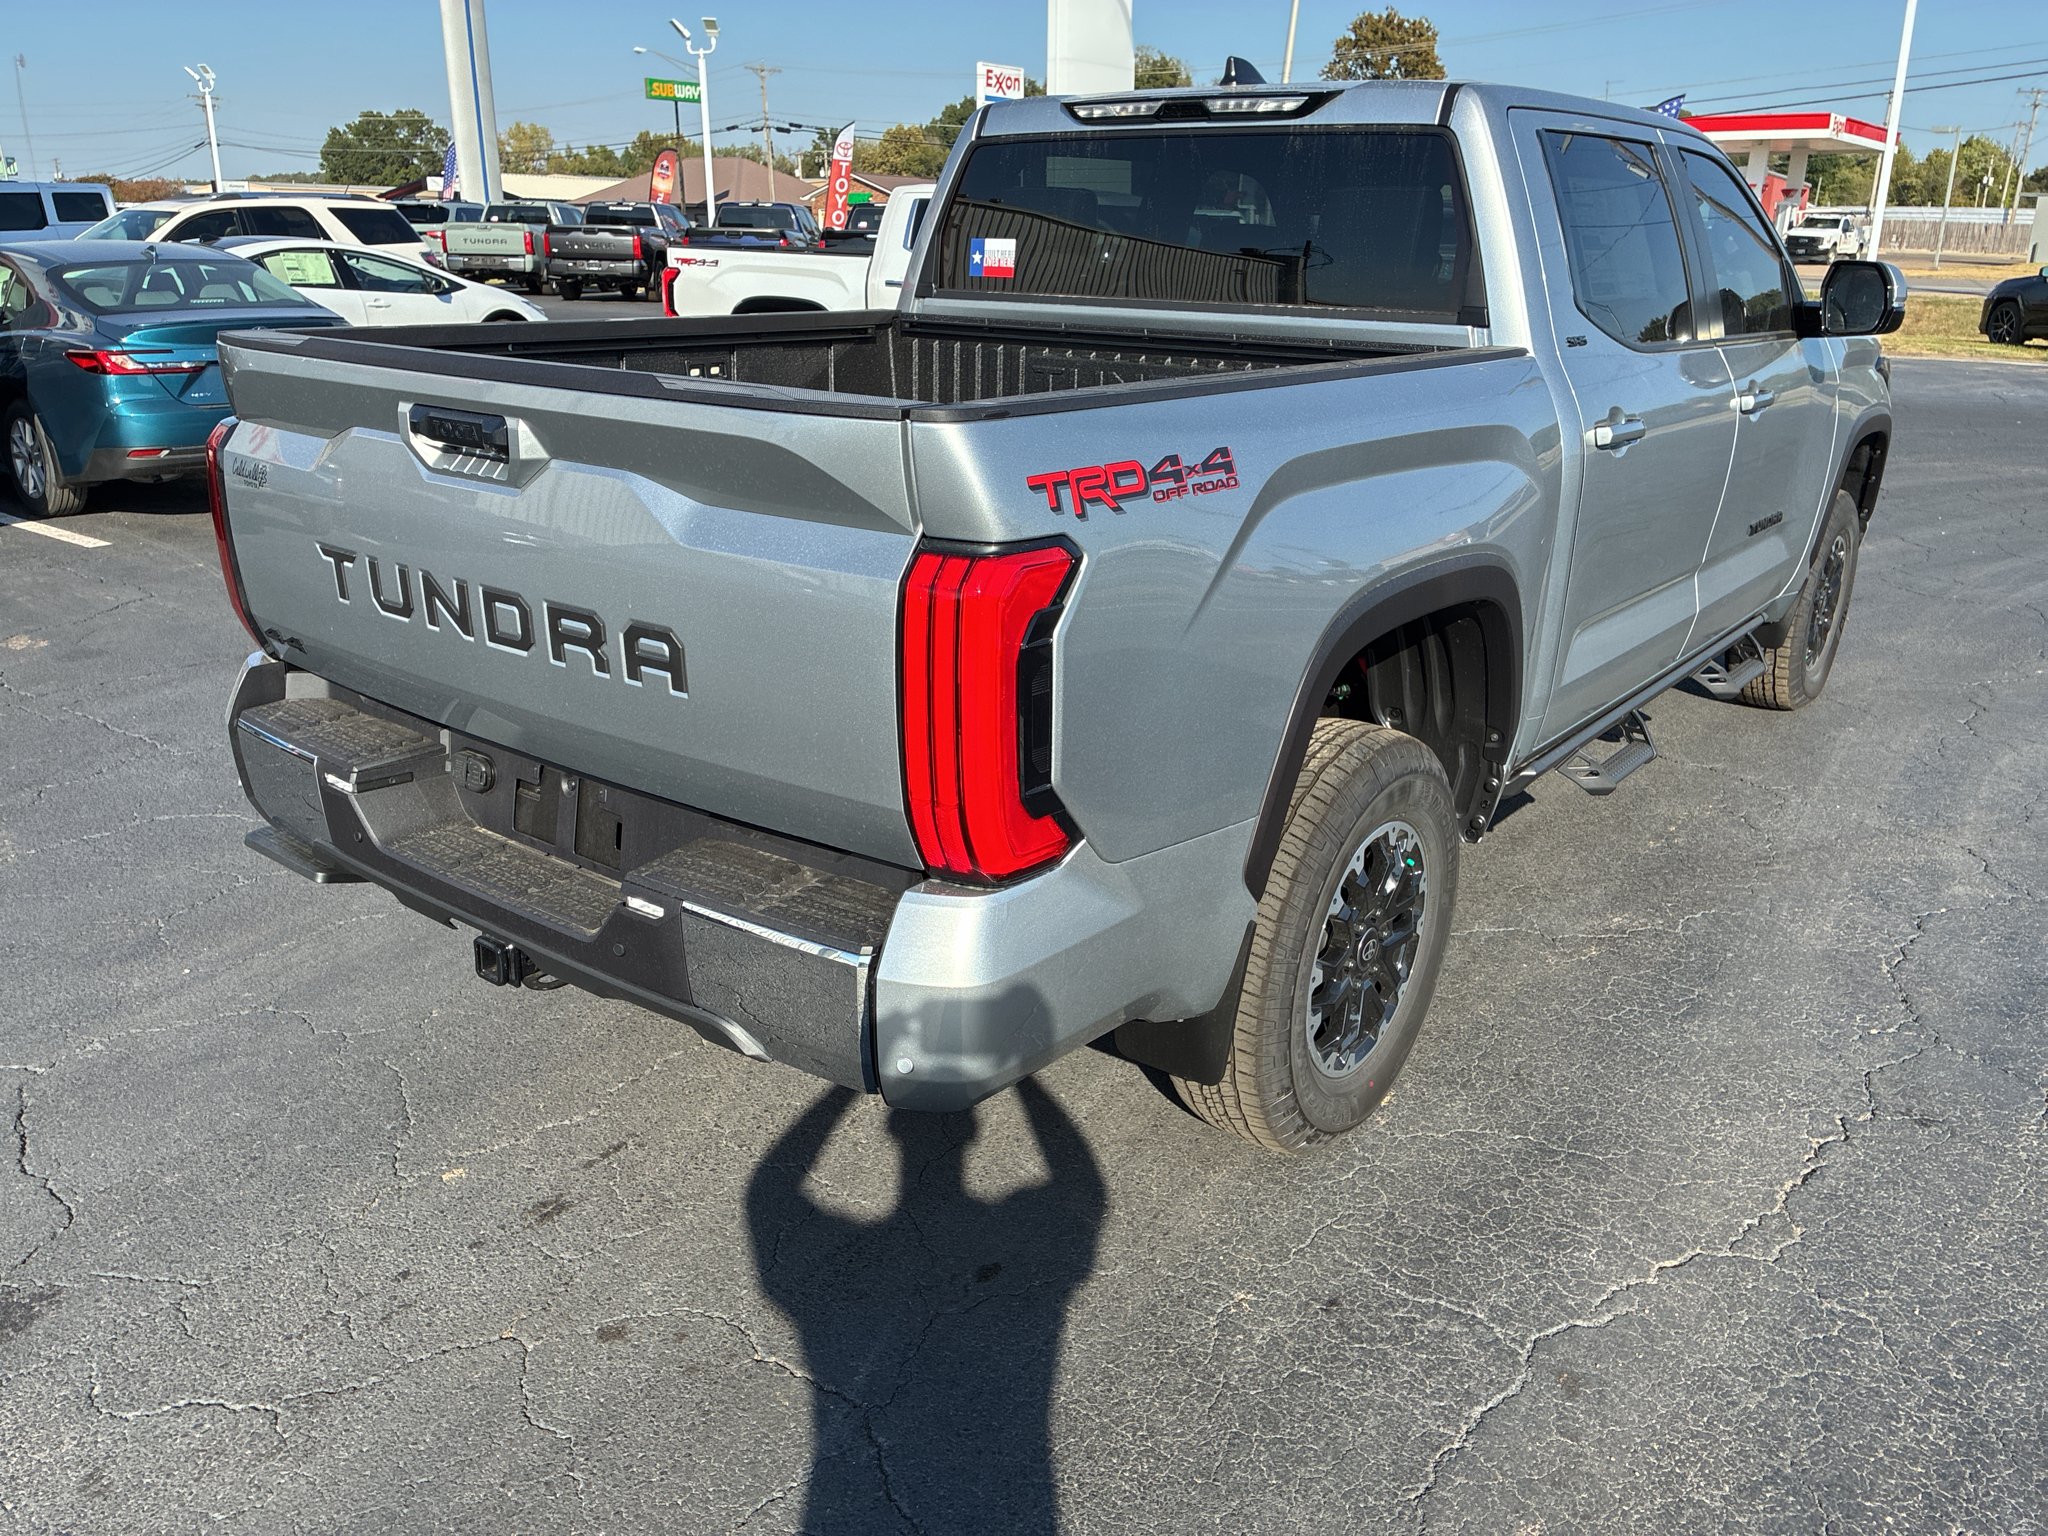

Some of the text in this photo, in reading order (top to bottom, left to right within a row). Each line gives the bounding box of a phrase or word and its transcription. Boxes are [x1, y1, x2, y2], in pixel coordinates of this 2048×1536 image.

[651, 82, 700, 99] SUBWAY
[986, 69, 1020, 96] Exxon
[831, 162, 849, 230] TOYO
[432, 419, 480, 441] TOYOTA
[1026, 446, 1237, 521] TRD 4x4
[1152, 475, 1240, 503] OFF ROAD
[315, 541, 688, 699] TUNDRA
